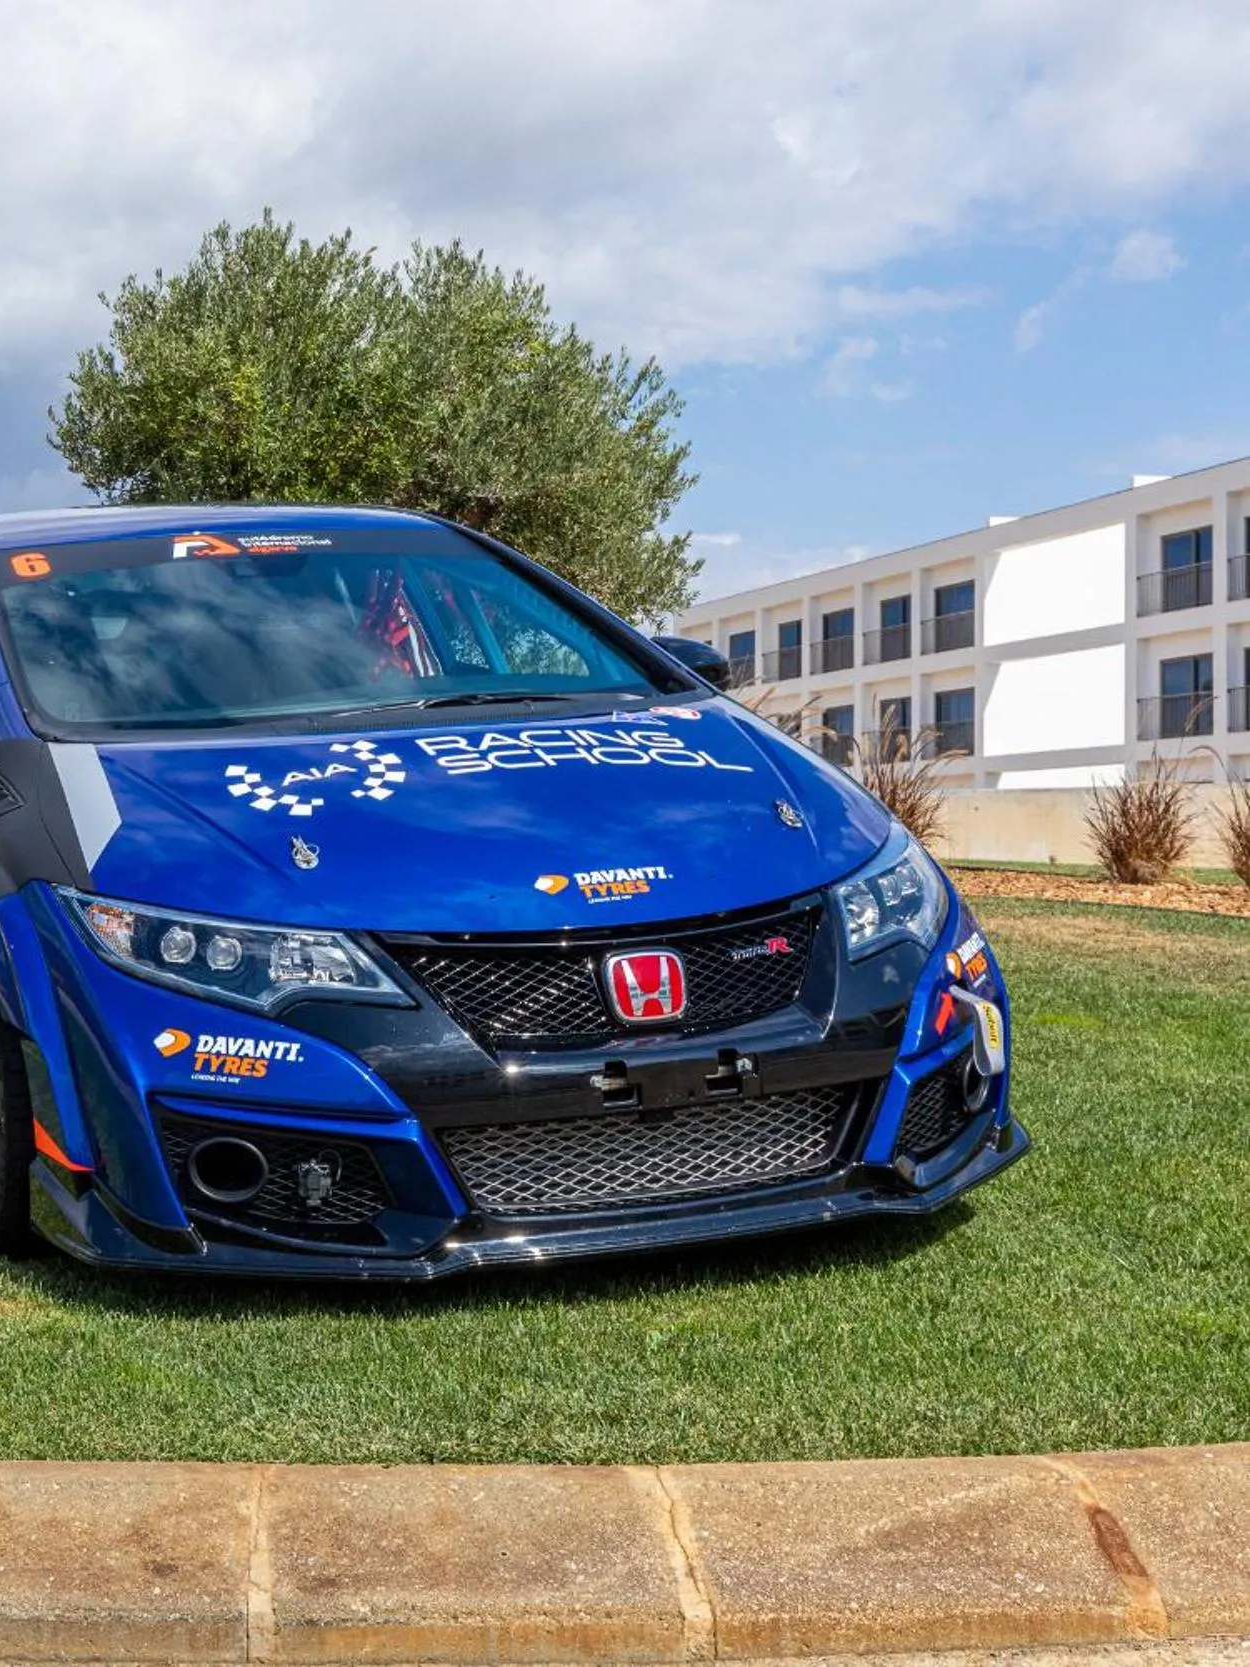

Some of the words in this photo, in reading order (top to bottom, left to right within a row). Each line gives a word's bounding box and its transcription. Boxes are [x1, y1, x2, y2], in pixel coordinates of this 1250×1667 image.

[10, 553, 51, 577] 6
[414, 729, 684, 757] RACING
[437, 747, 753, 774] SCHOOL
[281, 762, 358, 787] AIA
[580, 880, 651, 898] TYRES
[194, 1053, 269, 1078] TYRES
